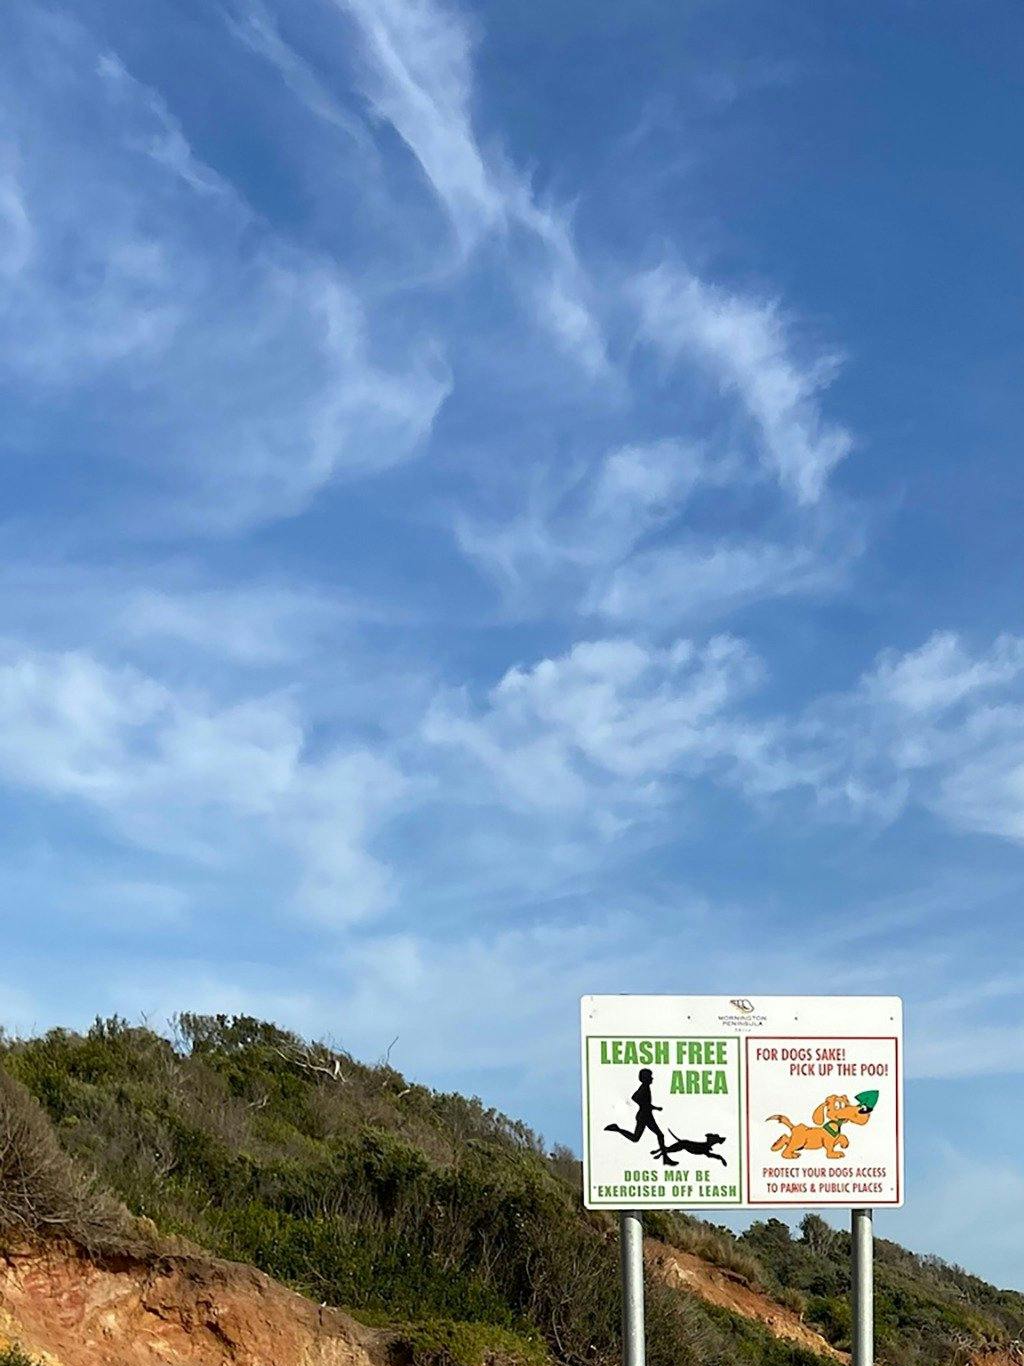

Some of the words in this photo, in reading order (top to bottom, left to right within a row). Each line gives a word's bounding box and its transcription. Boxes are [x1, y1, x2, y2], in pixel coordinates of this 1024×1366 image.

[600, 1041, 670, 1065] LEASH
[676, 1041, 728, 1065] FREE
[756, 1048, 778, 1061] FOR
[782, 1048, 812, 1061] DOGS
[816, 1048, 845, 1061] SAKE!
[790, 1064, 816, 1076] PICK
[818, 1064, 834, 1076] UP
[837, 1064, 858, 1076] THE
[860, 1064, 889, 1076] POO!
[670, 1070, 728, 1094] AREA
[624, 1170, 659, 1182] DOGS
[664, 1170, 691, 1182] MAY
[696, 1170, 710, 1182] BE
[763, 1167, 800, 1178] PROTECT
[802, 1167, 825, 1178] YOUR
[828, 1167, 854, 1178] DOGS
[856, 1168, 886, 1178] ACCESS
[598, 1185, 665, 1197] EXERCISED
[671, 1185, 693, 1197] OFF
[699, 1185, 737, 1197] LEASH
[767, 1183, 778, 1193] TO
[780, 1183, 806, 1193] PARKS
[809, 1183, 816, 1193] &
[819, 1183, 850, 1193] PUBLIC
[852, 1183, 883, 1193] PLACES
